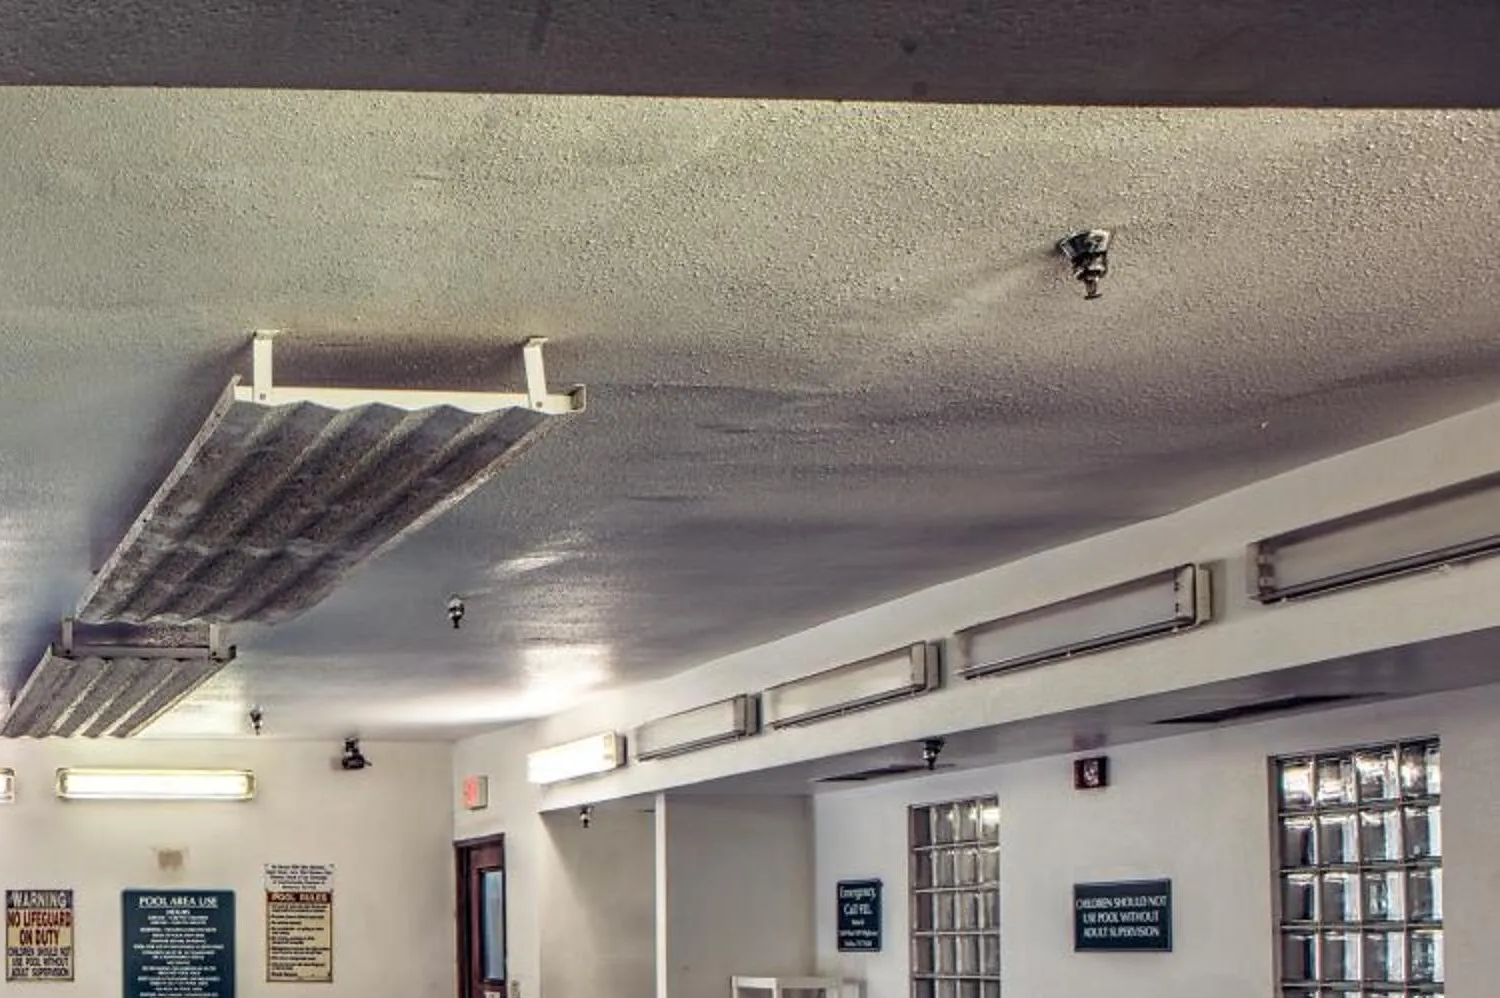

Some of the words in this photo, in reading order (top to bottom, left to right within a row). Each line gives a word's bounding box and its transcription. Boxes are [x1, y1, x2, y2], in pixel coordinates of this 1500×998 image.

[12, 892, 67, 909] WARNING
[139, 896, 167, 905] POOL
[169, 896, 197, 905] AREA
[200, 896, 218, 905] USE
[1076, 898, 1113, 909] CHILDREN
[1113, 896, 1147, 908] SHOULD
[1148, 896, 1167, 906] NOT
[8, 911, 20, 928] NO
[23, 911, 71, 927] LIFEGUARD
[1083, 911, 1097, 924] USE
[1097, 911, 1118, 923] POOL
[1119, 911, 1159, 922] WITHOUT
[20, 929, 33, 946] ON
[35, 929, 59, 945] DUTY
[1083, 927, 1108, 937] ADULT
[1109, 926, 1160, 937] SUPERVISION
[26, 957, 41, 967] POOL
[43, 957, 69, 967] WITHOUT
[12, 967, 29, 977] ADULT
[32, 967, 69, 977] SUPERVISION
